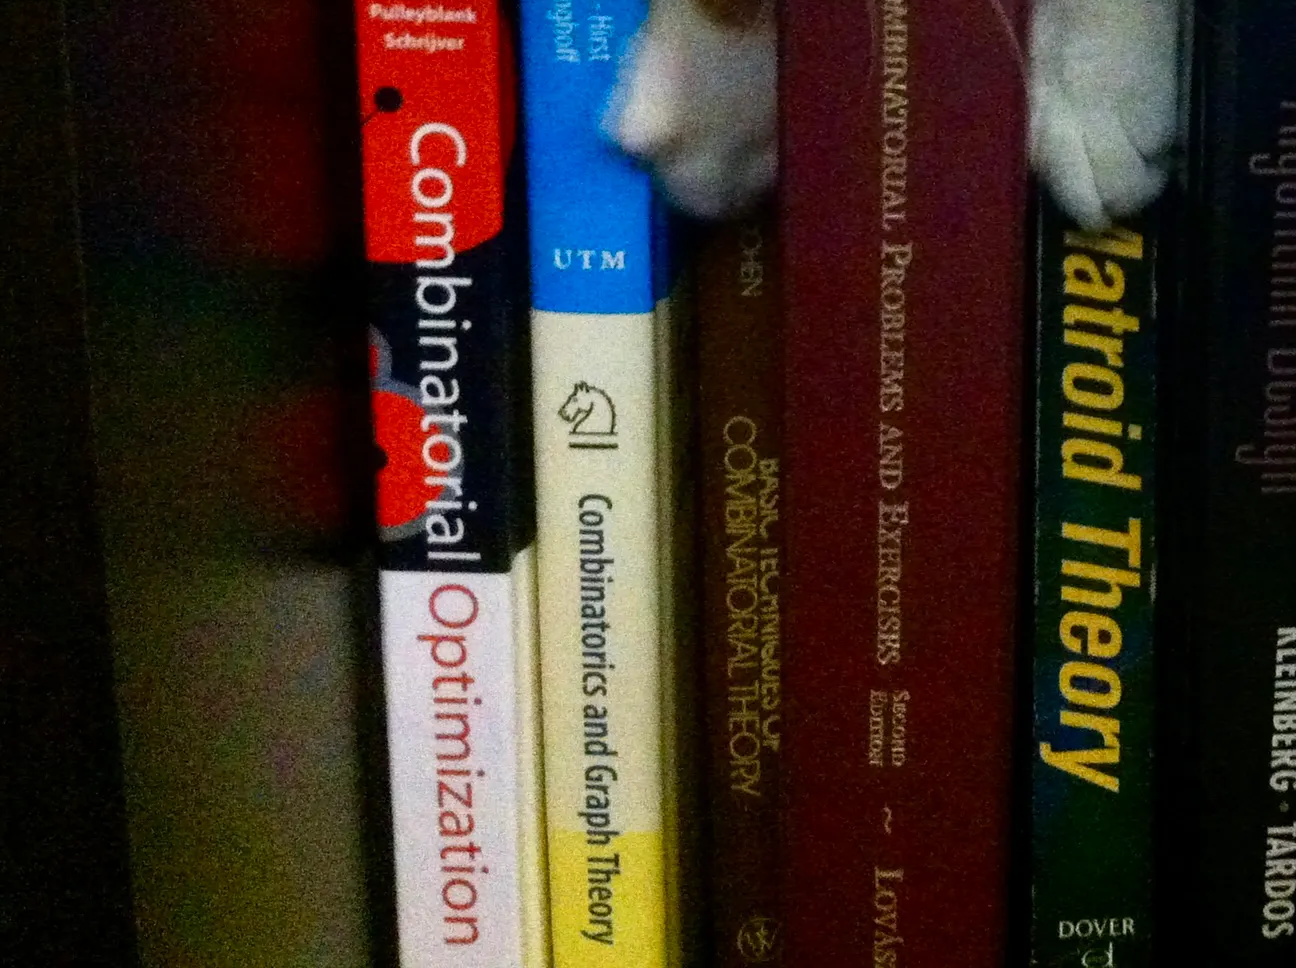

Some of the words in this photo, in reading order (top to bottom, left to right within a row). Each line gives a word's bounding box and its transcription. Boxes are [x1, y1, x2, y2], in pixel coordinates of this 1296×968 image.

[587, 15, 613, 61] Hirst
[552, 249, 626, 271] UTM
[409, 121, 481, 565] Combinatorial
[877, 421, 905, 489] AND
[723, 415, 761, 678] COMBINATORIAL
[578, 494, 615, 697] Combinatorics
[1037, 516, 1141, 793] Theory
[417, 583, 489, 946] Optimization
[582, 705, 618, 757] and
[726, 680, 761, 797] THEORY
[577, 764, 618, 852] Graph
[579, 853, 619, 946] Theory
[1058, 916, 1135, 939] DOVER
